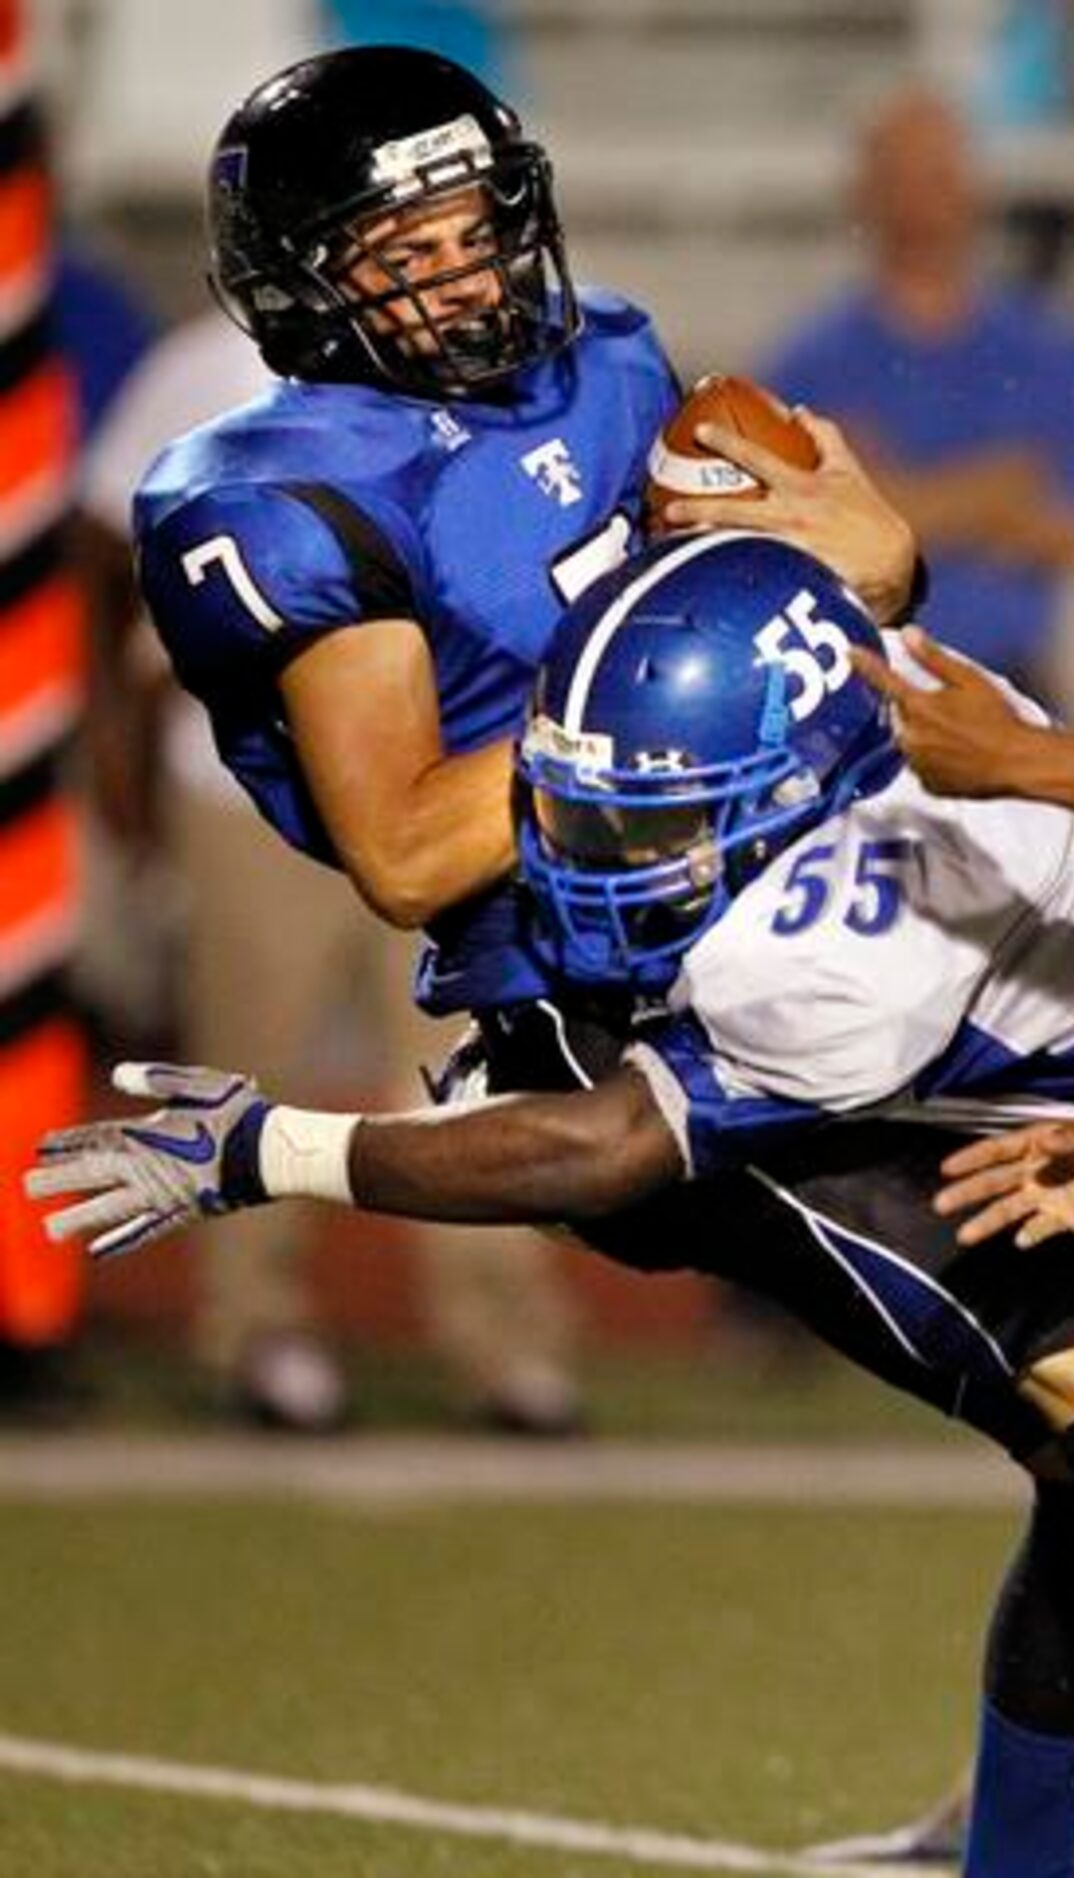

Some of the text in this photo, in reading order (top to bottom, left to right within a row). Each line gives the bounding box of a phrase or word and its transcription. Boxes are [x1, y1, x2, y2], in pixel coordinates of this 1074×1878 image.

[182, 535, 284, 632] 7
[753, 590, 852, 721] 55
[770, 841, 911, 936] 55
